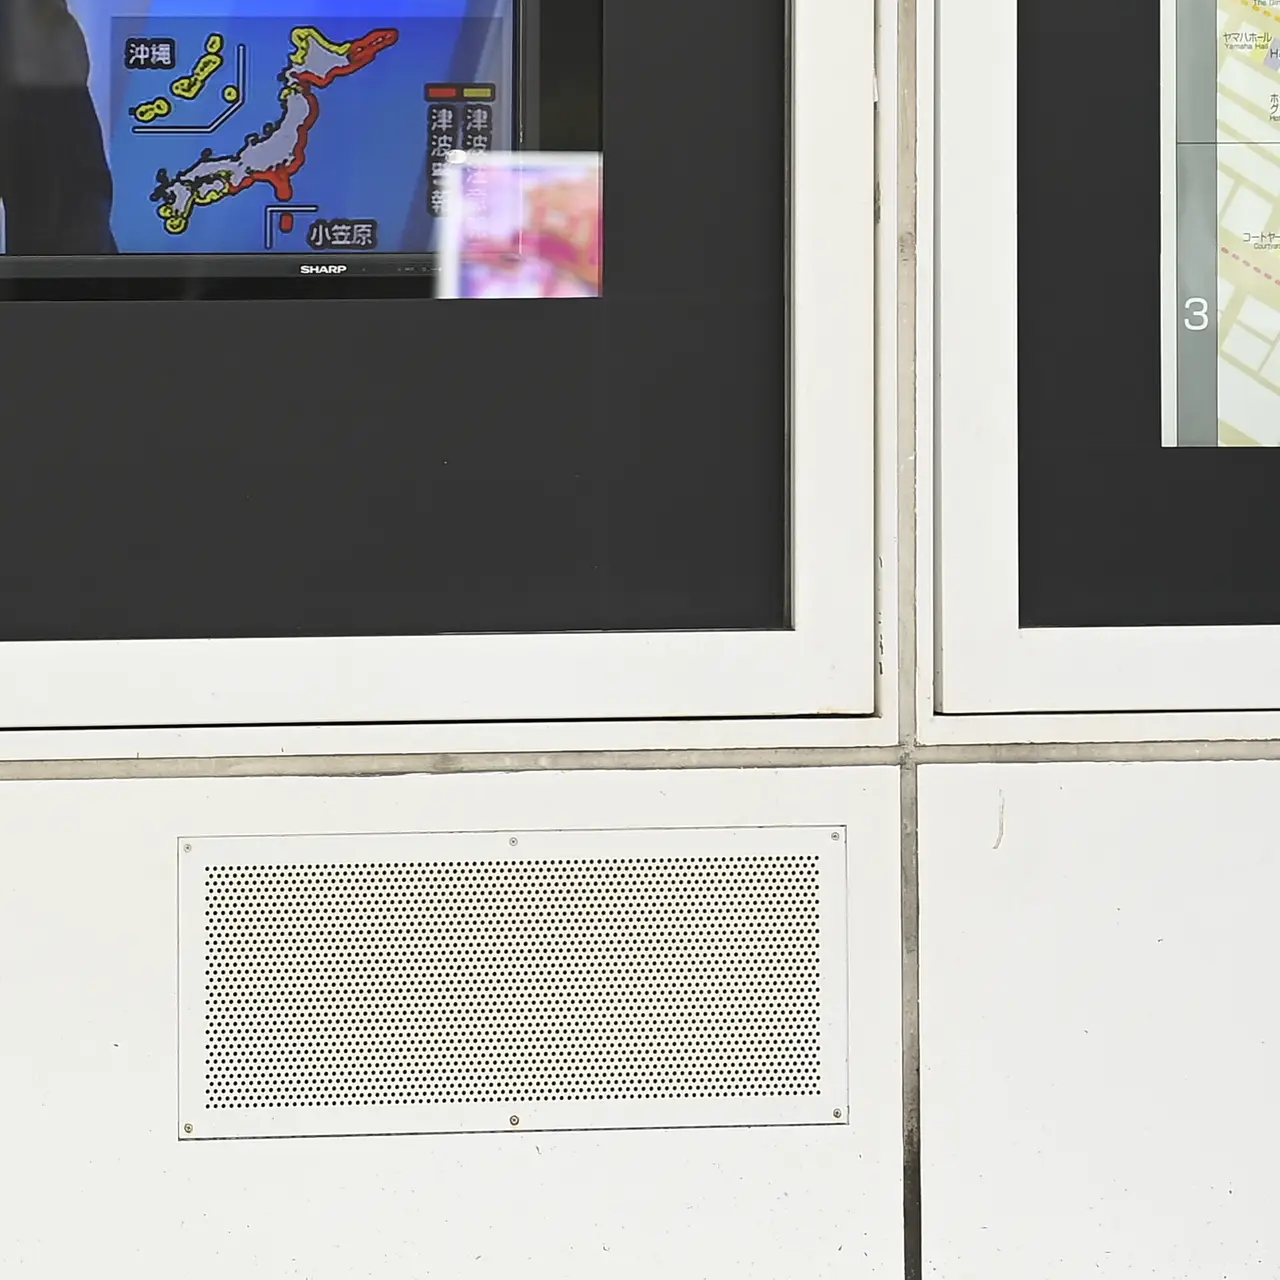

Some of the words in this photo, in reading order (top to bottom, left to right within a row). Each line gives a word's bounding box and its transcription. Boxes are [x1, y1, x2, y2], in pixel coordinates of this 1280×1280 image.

[1223, 32, 1273, 43] ヤマハホール
[129, 43, 172, 66] 沖縄
[310, 224, 373, 246] 小笠原
[300, 265, 348, 274] SHARP
[1183, 297, 1209, 331] 3
